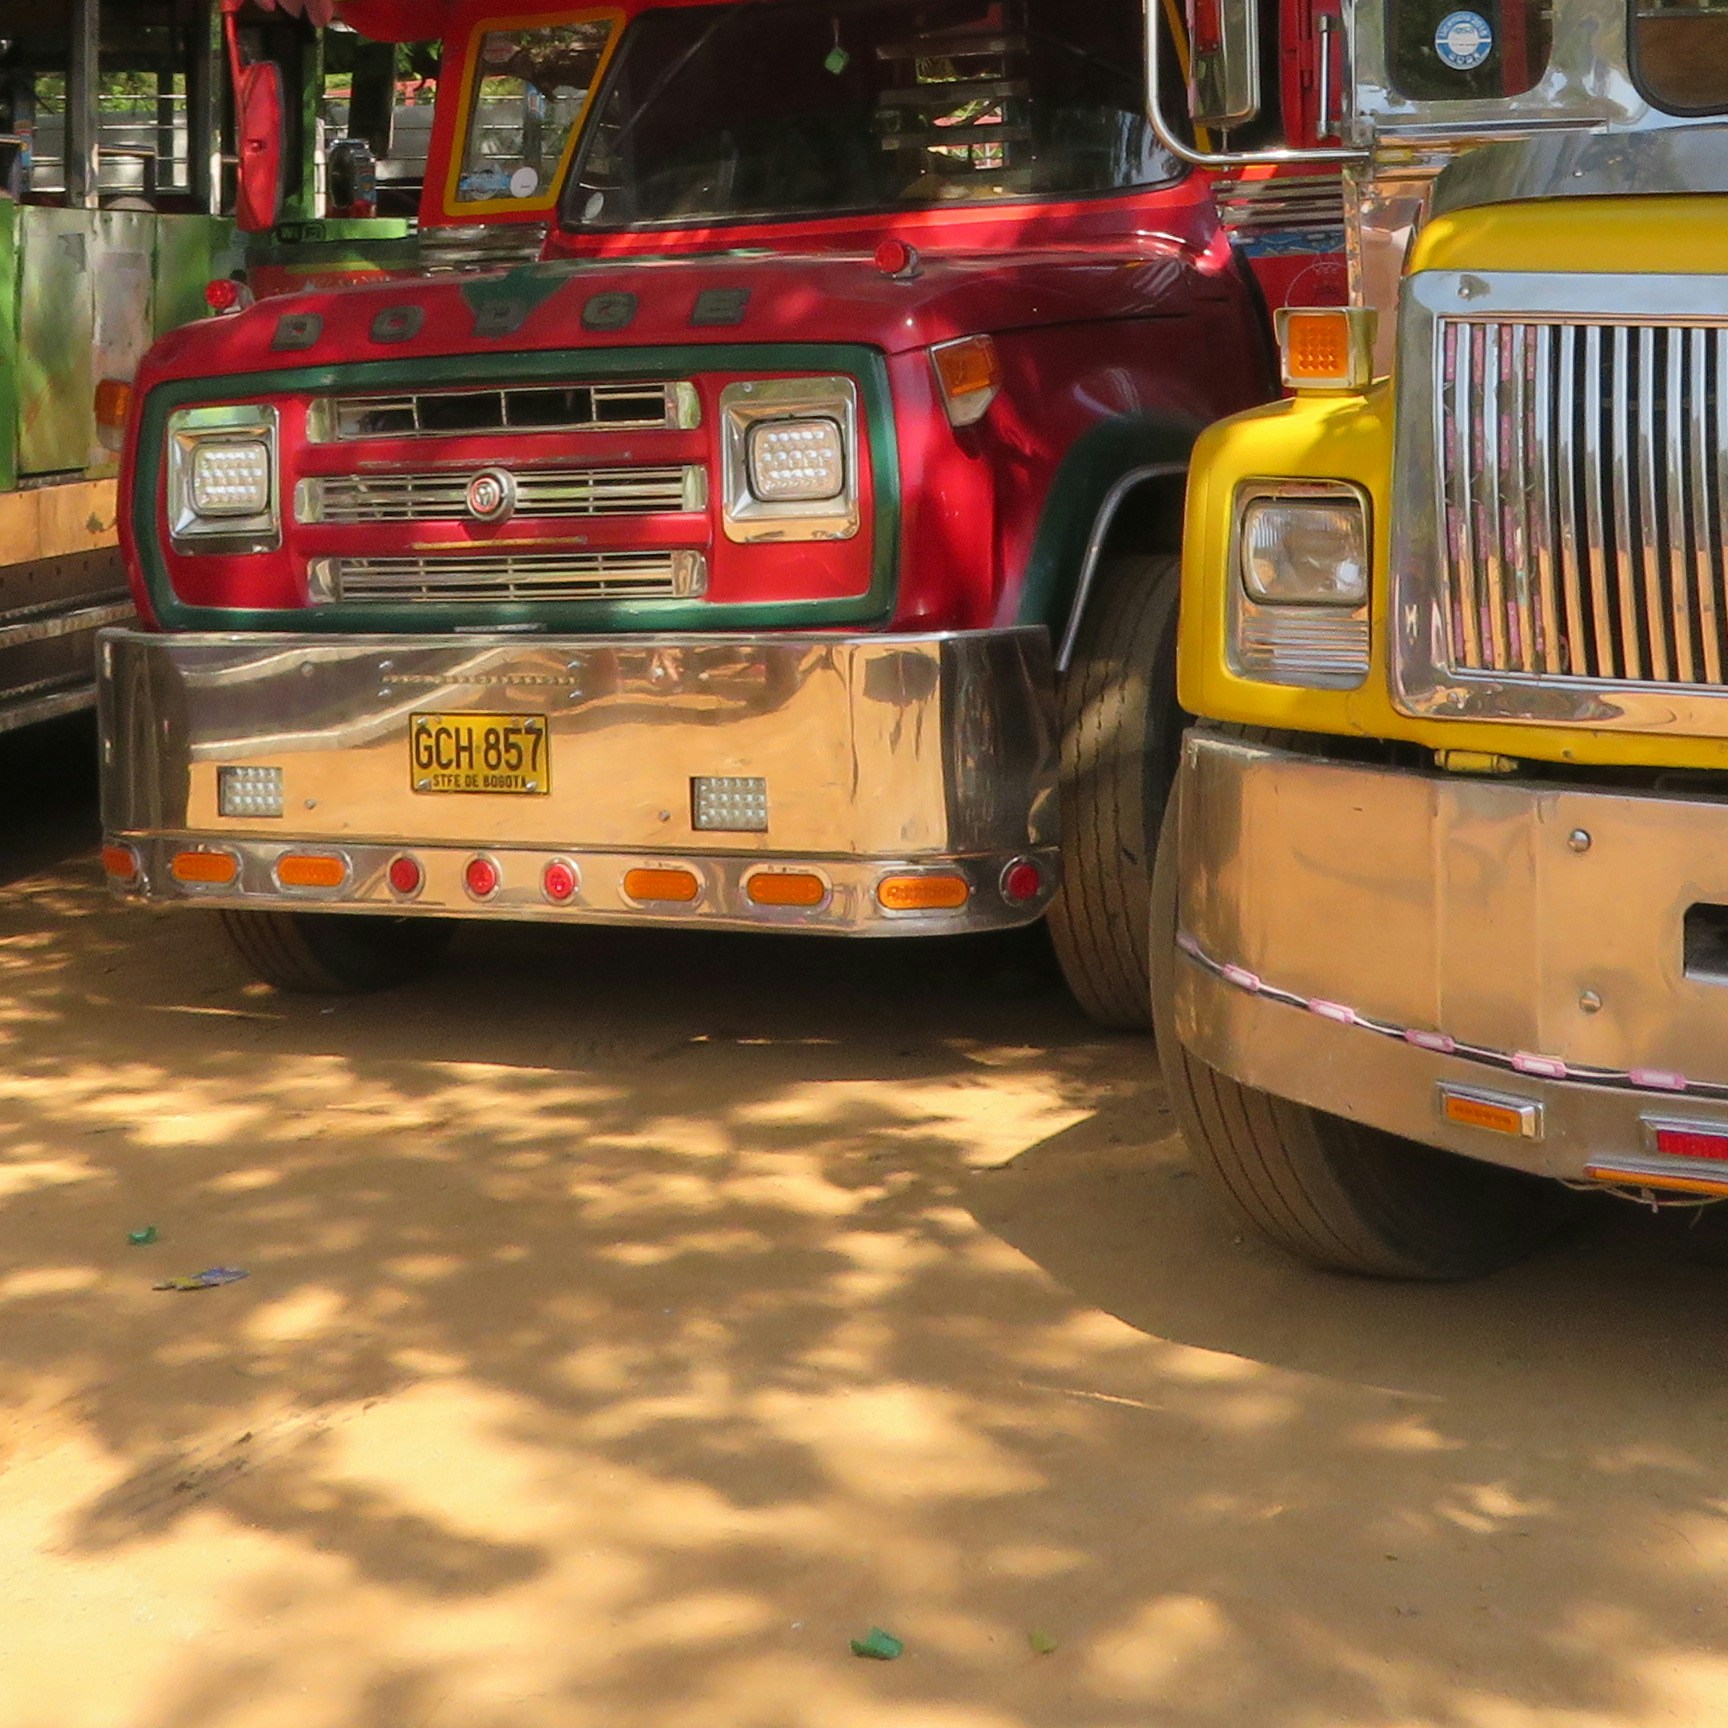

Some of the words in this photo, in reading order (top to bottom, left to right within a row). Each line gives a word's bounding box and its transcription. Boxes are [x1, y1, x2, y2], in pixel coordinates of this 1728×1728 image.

[272, 287, 751, 351] DODGE
[414, 726, 473, 771] GCH
[483, 727, 544, 772] 857
[464, 774, 480, 788] DE
